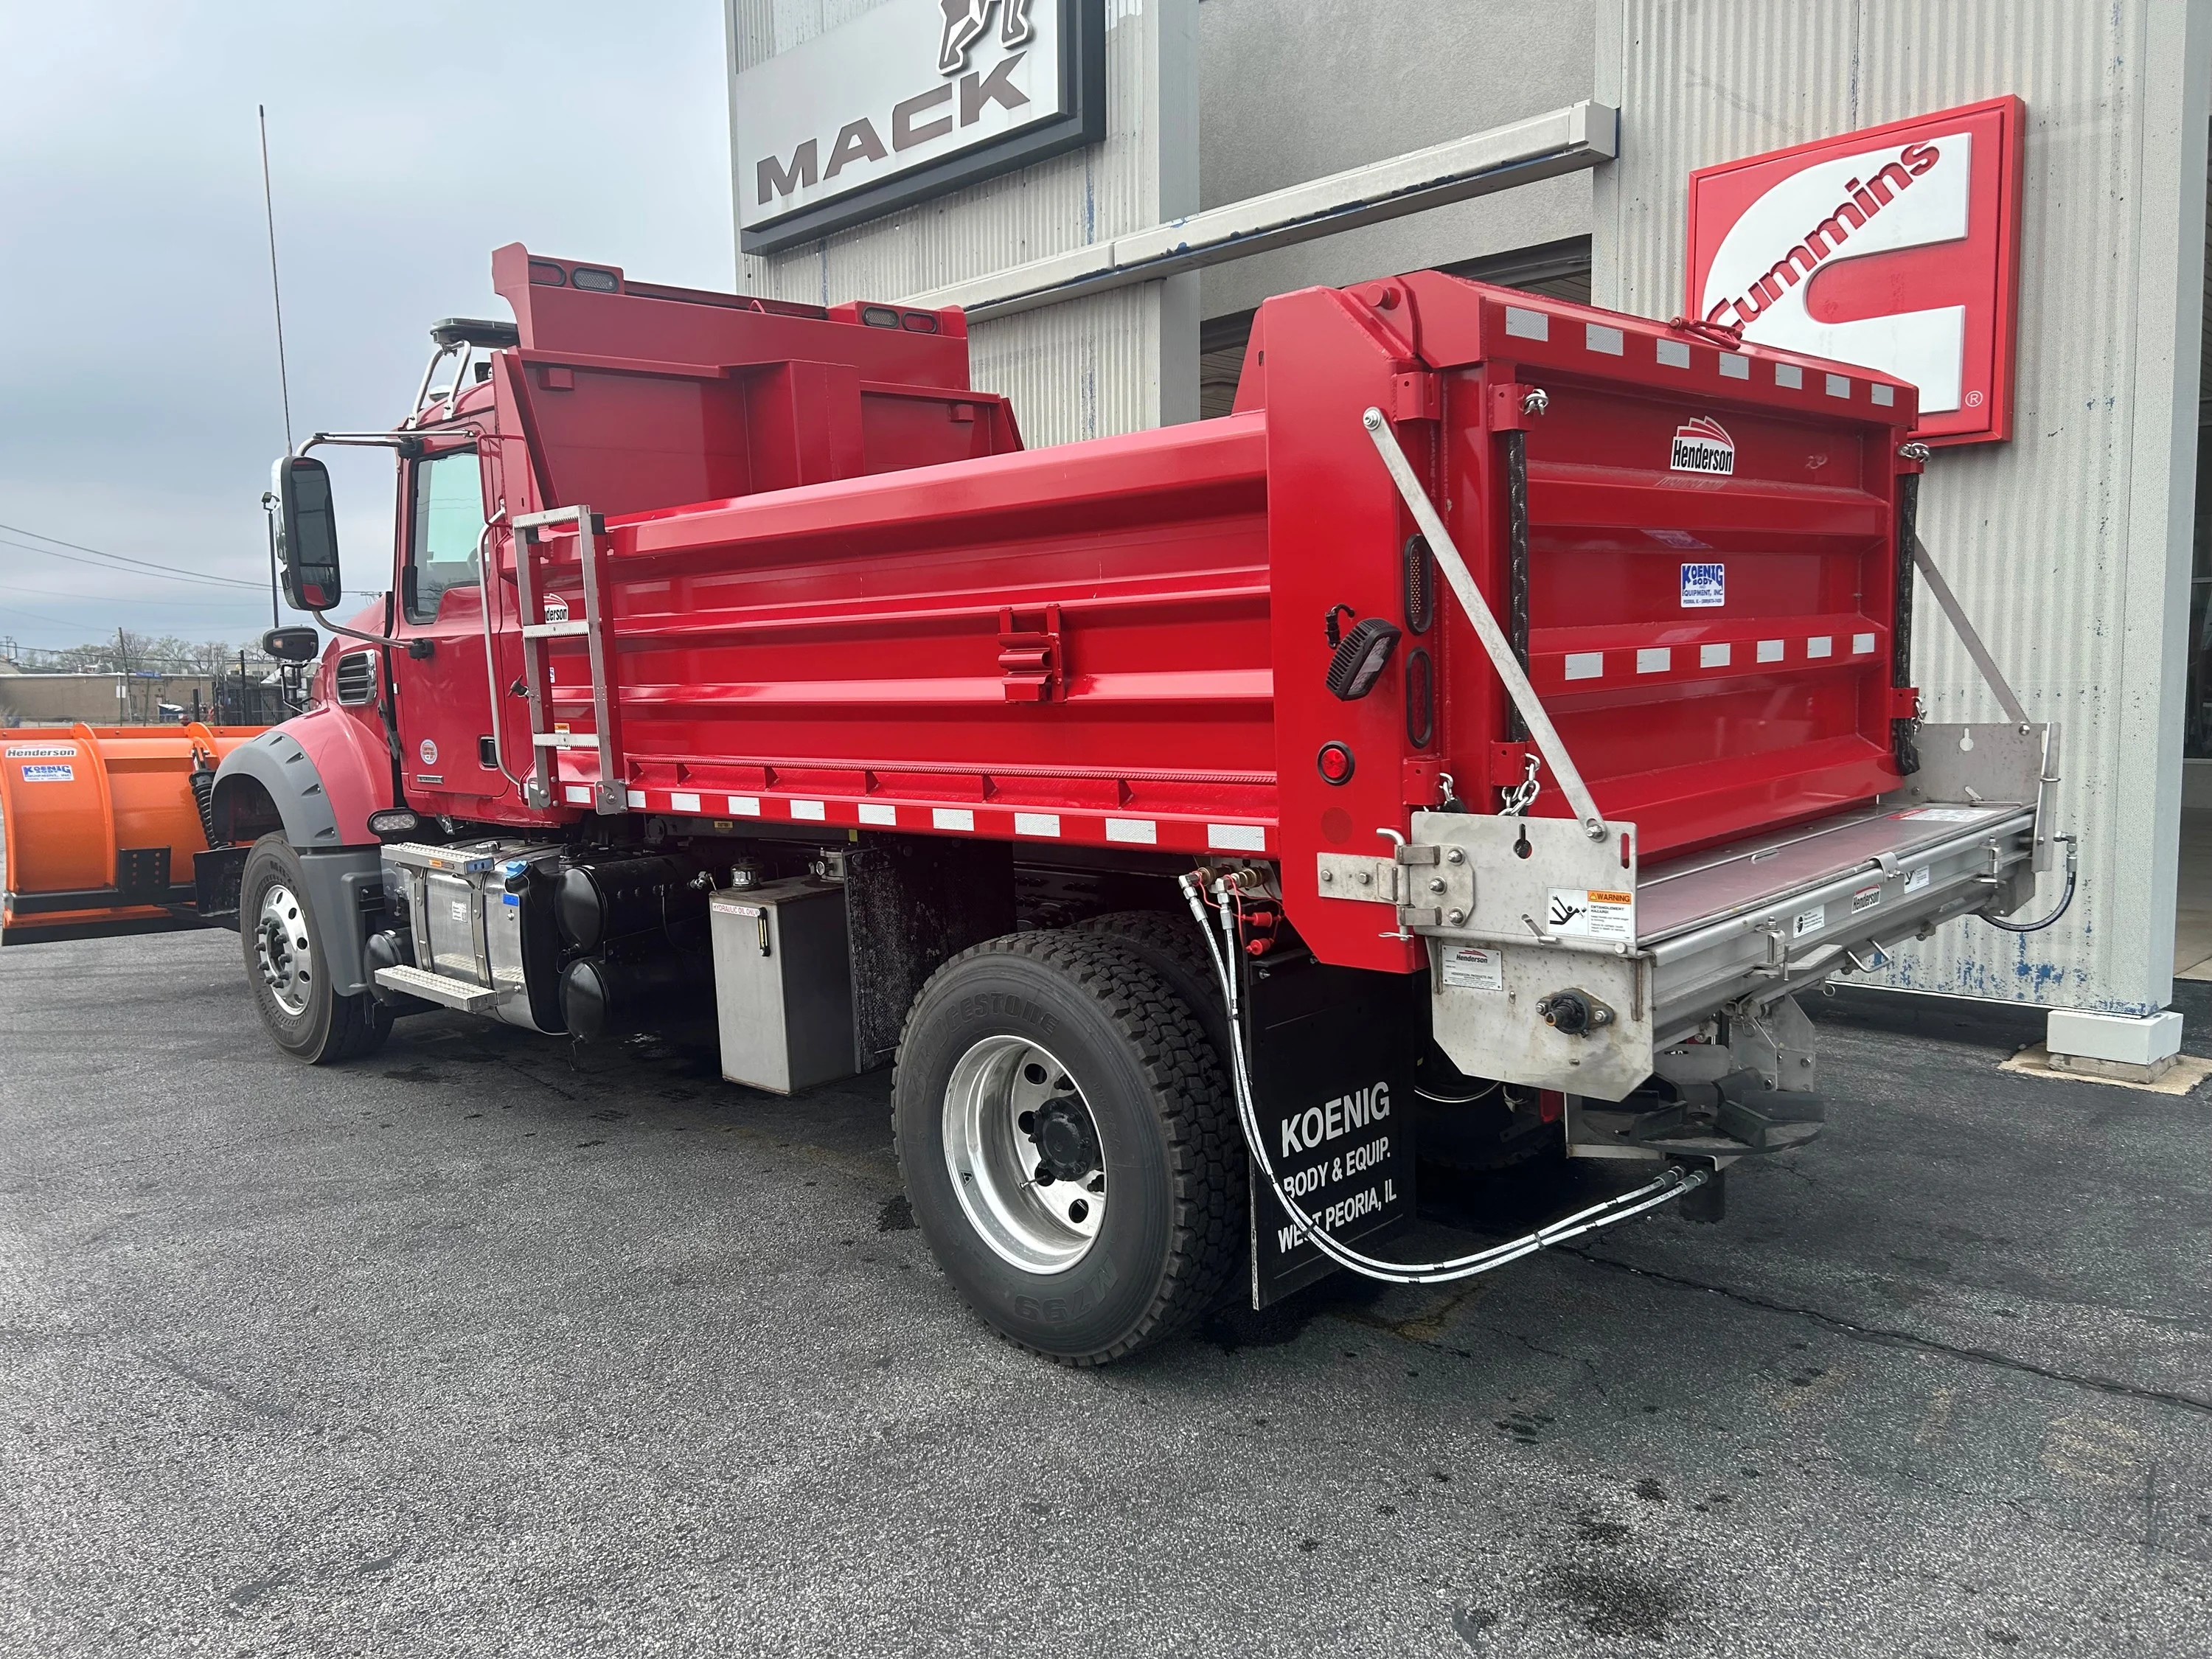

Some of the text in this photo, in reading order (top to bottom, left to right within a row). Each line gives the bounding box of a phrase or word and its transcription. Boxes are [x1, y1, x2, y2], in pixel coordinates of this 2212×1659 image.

[757, 51, 1030, 205] MACK
[1705, 139, 1940, 332] Cummins
[1672, 439, 1733, 472] Henderson
[1682, 565, 1723, 590] KOENIG
[1692, 577, 1713, 585] BODY
[546, 607, 567, 621] derson
[23, 765, 72, 775] KOENIG
[1596, 893, 1630, 902] WARNING
[1852, 891, 1879, 912] Henderson
[1456, 953, 1488, 964] Henderson
[905, 991, 1060, 1102] BRIDGESTONE
[1281, 1081, 1391, 1158] KOENIG
[1284, 1136, 1391, 1198] BODY & EQUIP.
[1278, 1211, 1322, 1253] WET
[1326, 1187, 1382, 1231] PEORIA,
[1385, 1179, 1397, 1203] IL
